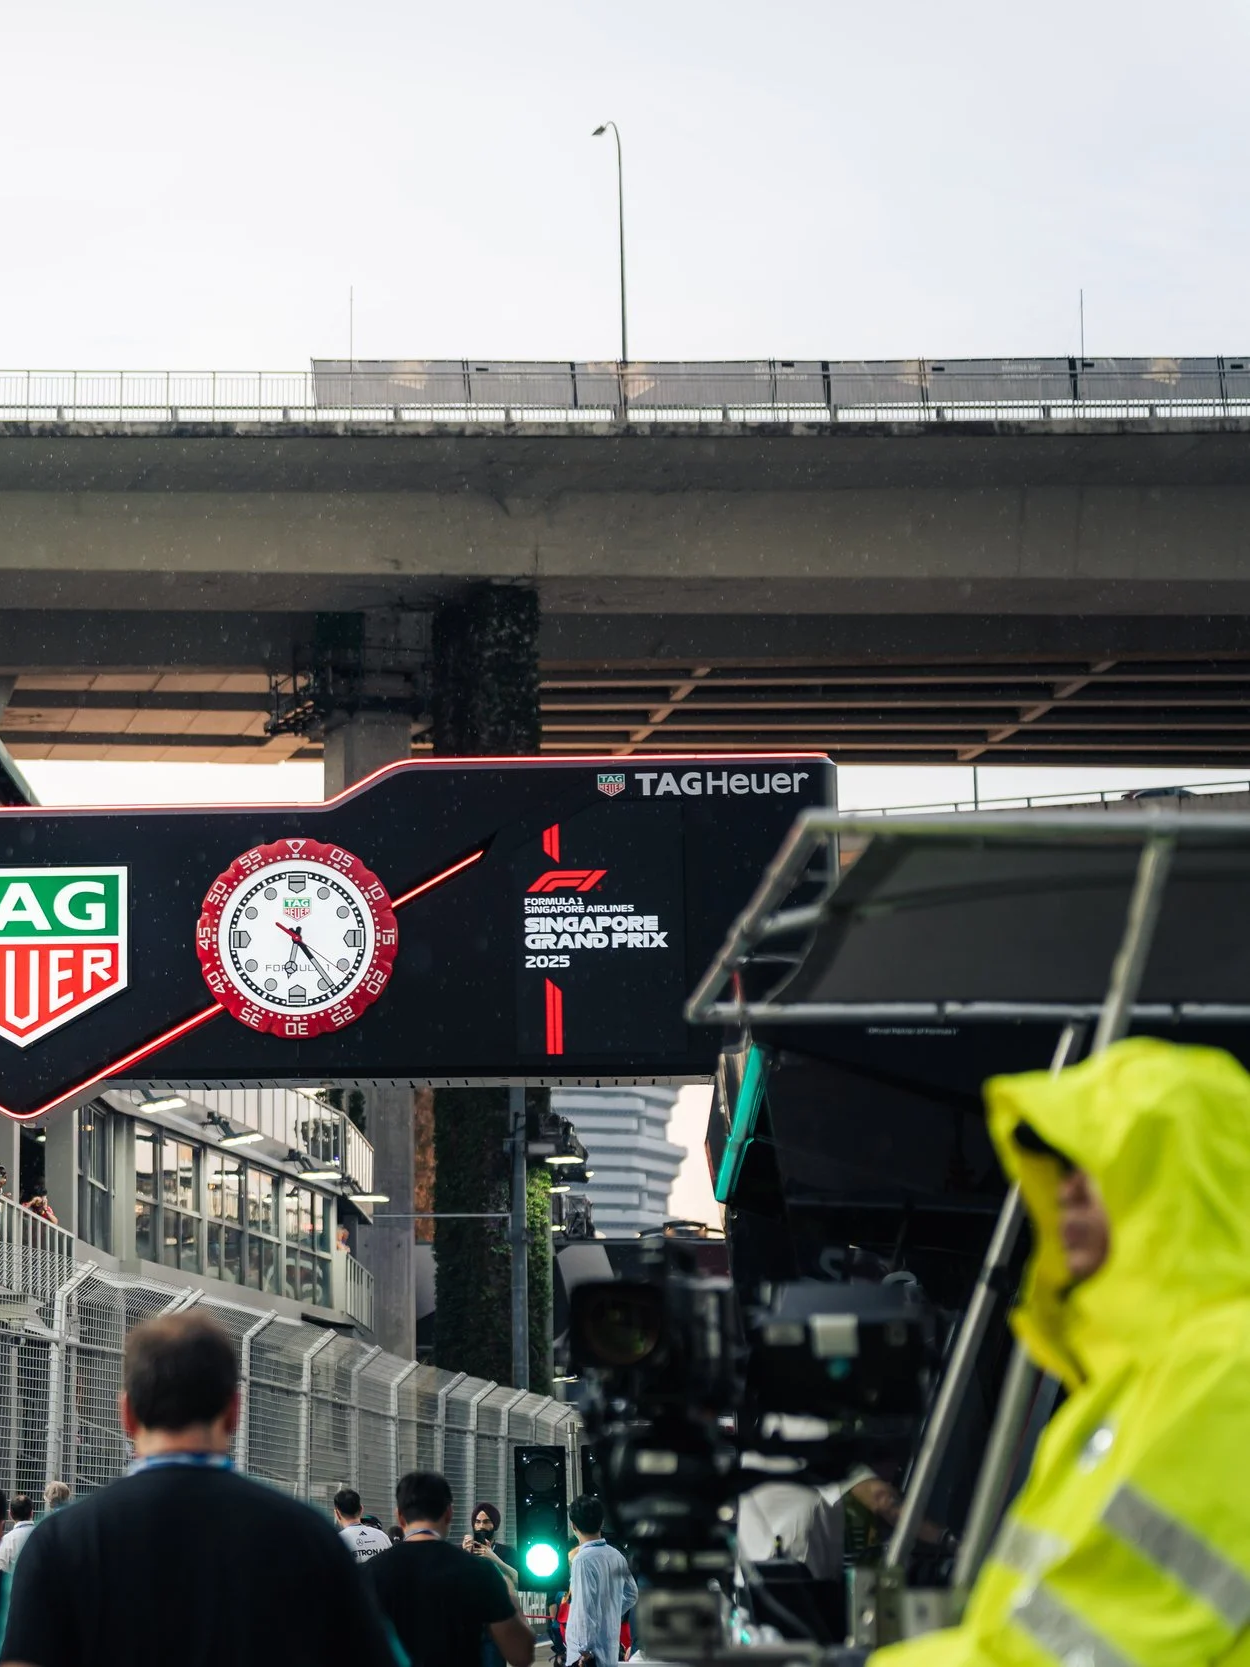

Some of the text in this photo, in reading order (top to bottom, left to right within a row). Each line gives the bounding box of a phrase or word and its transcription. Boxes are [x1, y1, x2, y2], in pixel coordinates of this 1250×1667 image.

[601, 775, 623, 783] TAG
[238, 850, 262, 869] 55
[330, 848, 355, 867] 05
[207, 881, 227, 904] 50
[367, 881, 385, 900] 10
[286, 899, 310, 907] TAG
[524, 897, 584, 906] FORMULA 1
[524, 904, 635, 914] SINGAPORE AIRLINES
[284, 907, 311, 920] HEUER
[524, 915, 659, 933] SINGAPORE
[199, 927, 211, 950] 45
[382, 928, 395, 945] 15
[524, 932, 669, 950] GRAND PRIX
[525, 955, 571, 968] 2025
[207, 971, 226, 993] 40
[366, 971, 387, 994] 20
[239, 1007, 263, 1027] 35
[330, 1006, 355, 1027] 25
[285, 1022, 309, 1035] 30
